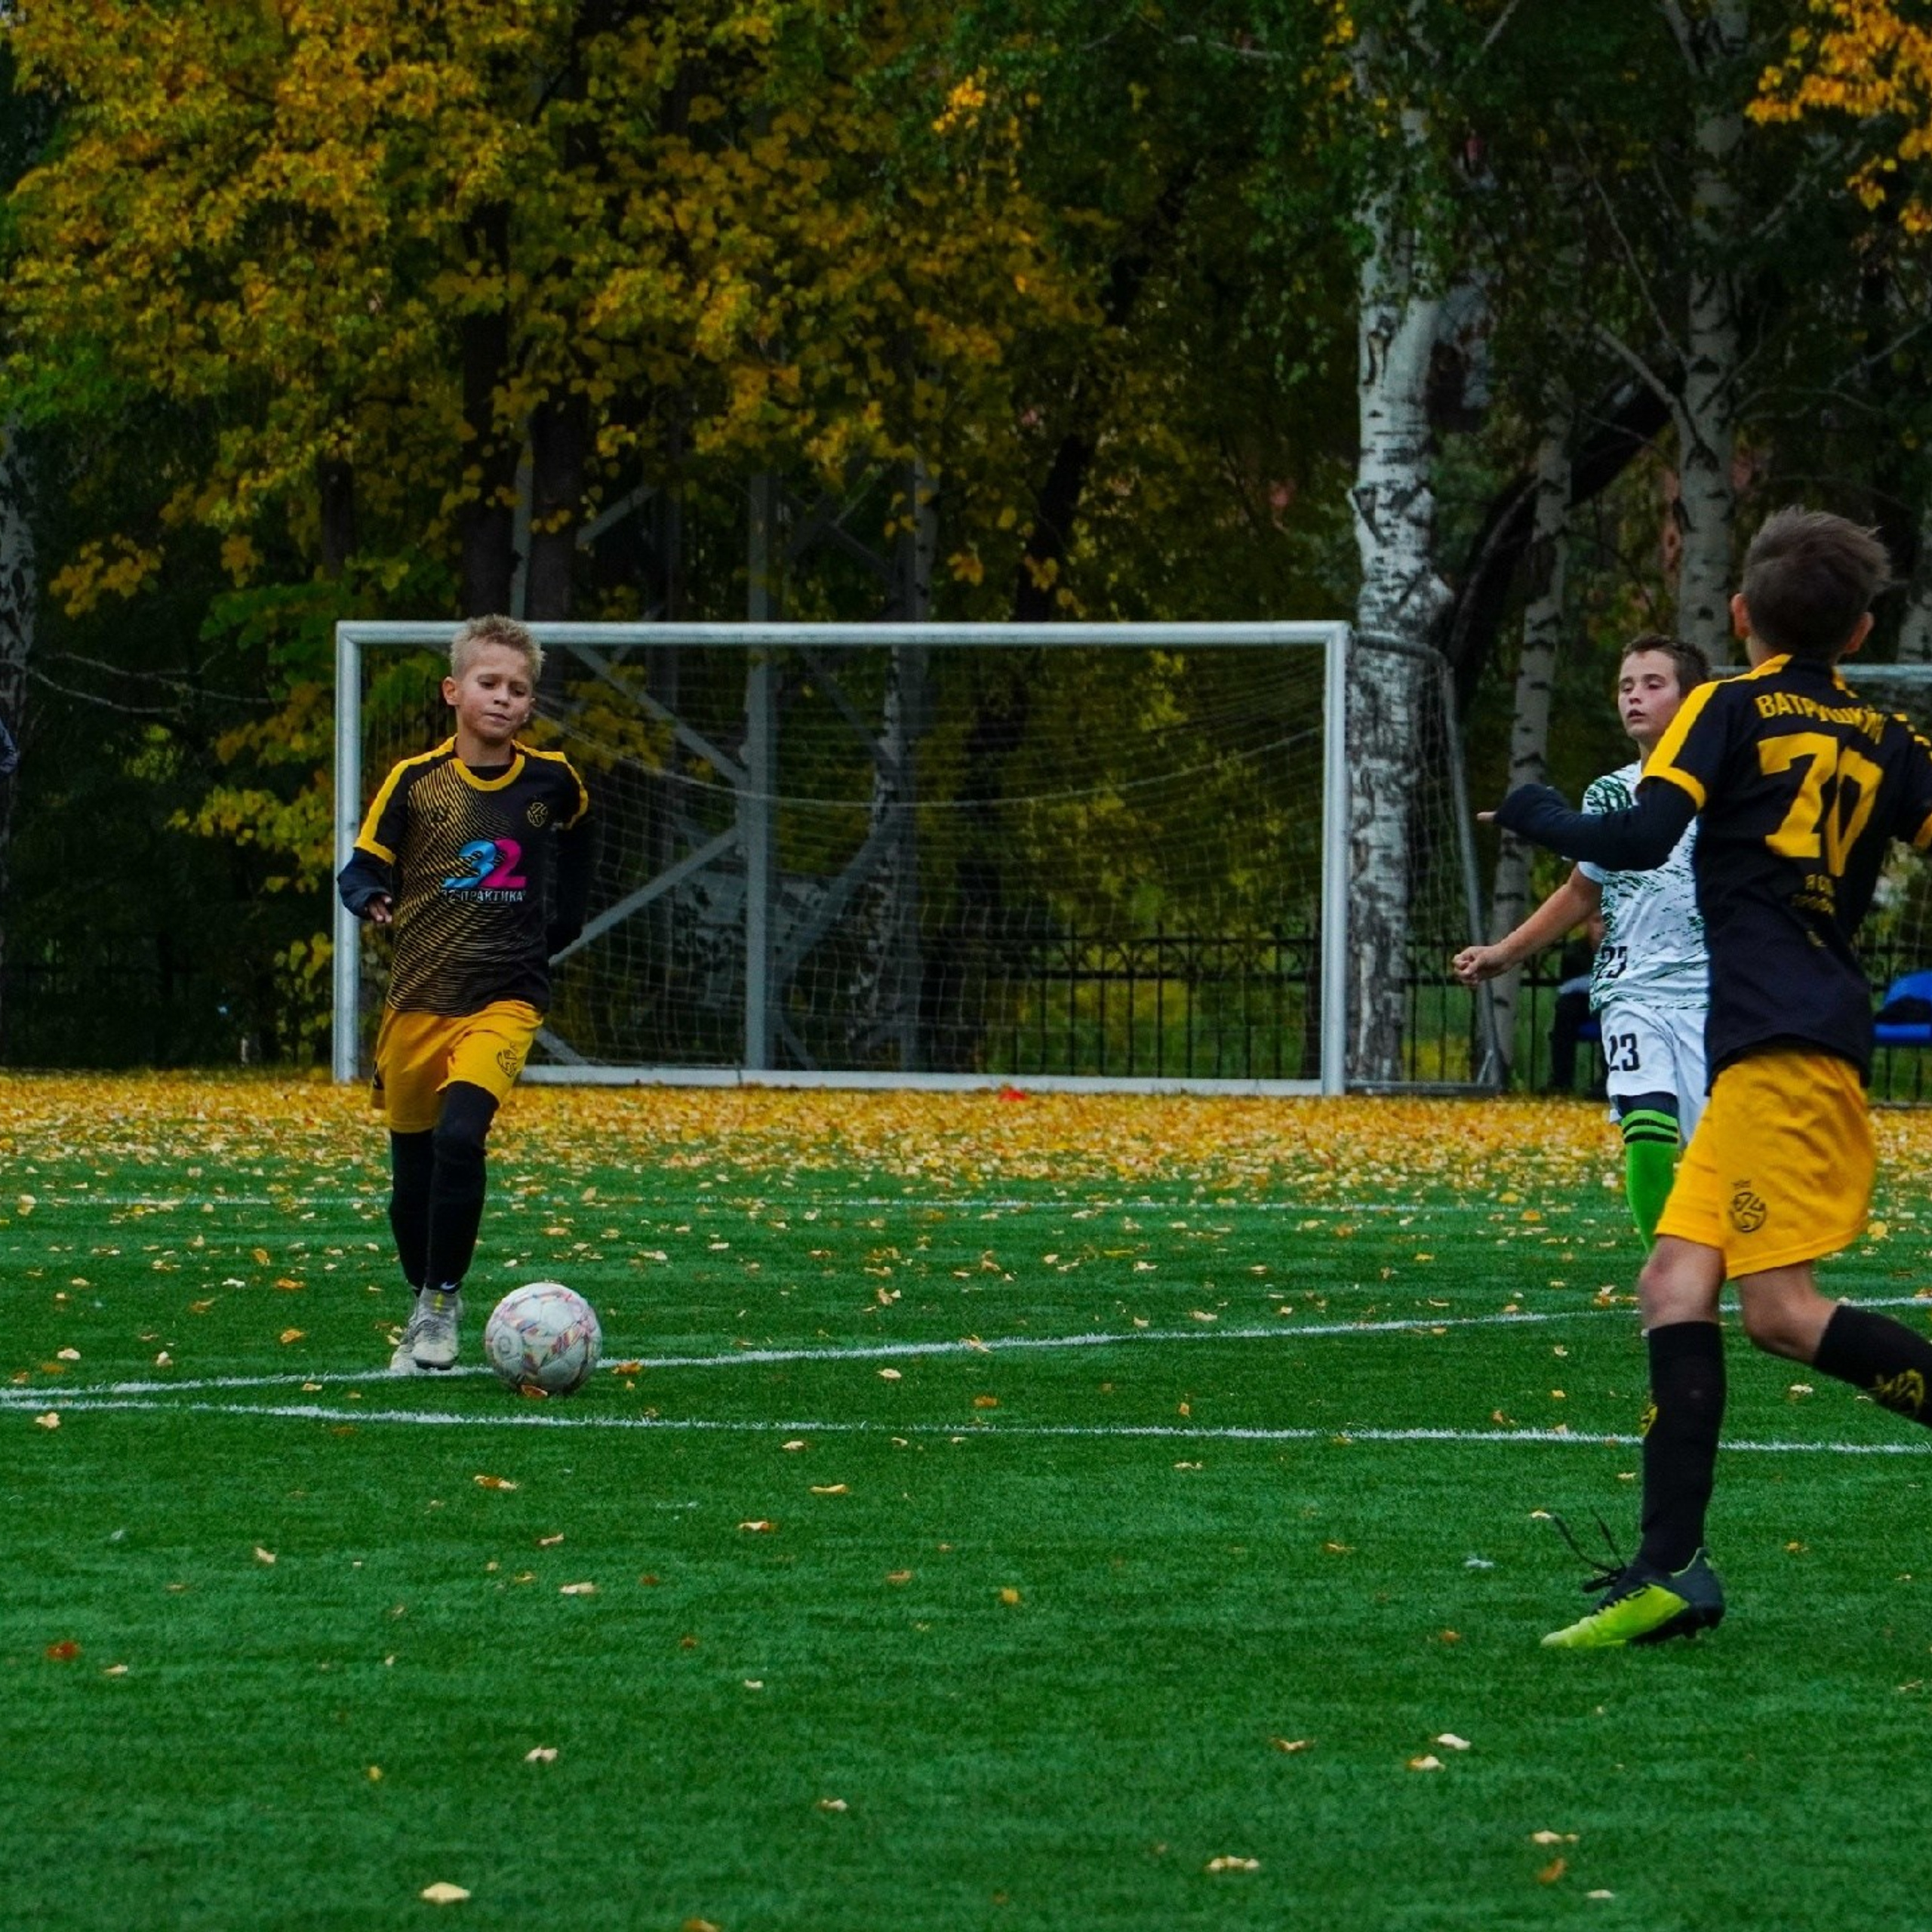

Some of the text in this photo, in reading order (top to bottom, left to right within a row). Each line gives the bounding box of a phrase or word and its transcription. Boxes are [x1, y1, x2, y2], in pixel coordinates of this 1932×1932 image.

[1758, 731, 1883, 877] 70
[441, 838, 527, 890] 32
[1608, 1032, 1641, 1072] 23
